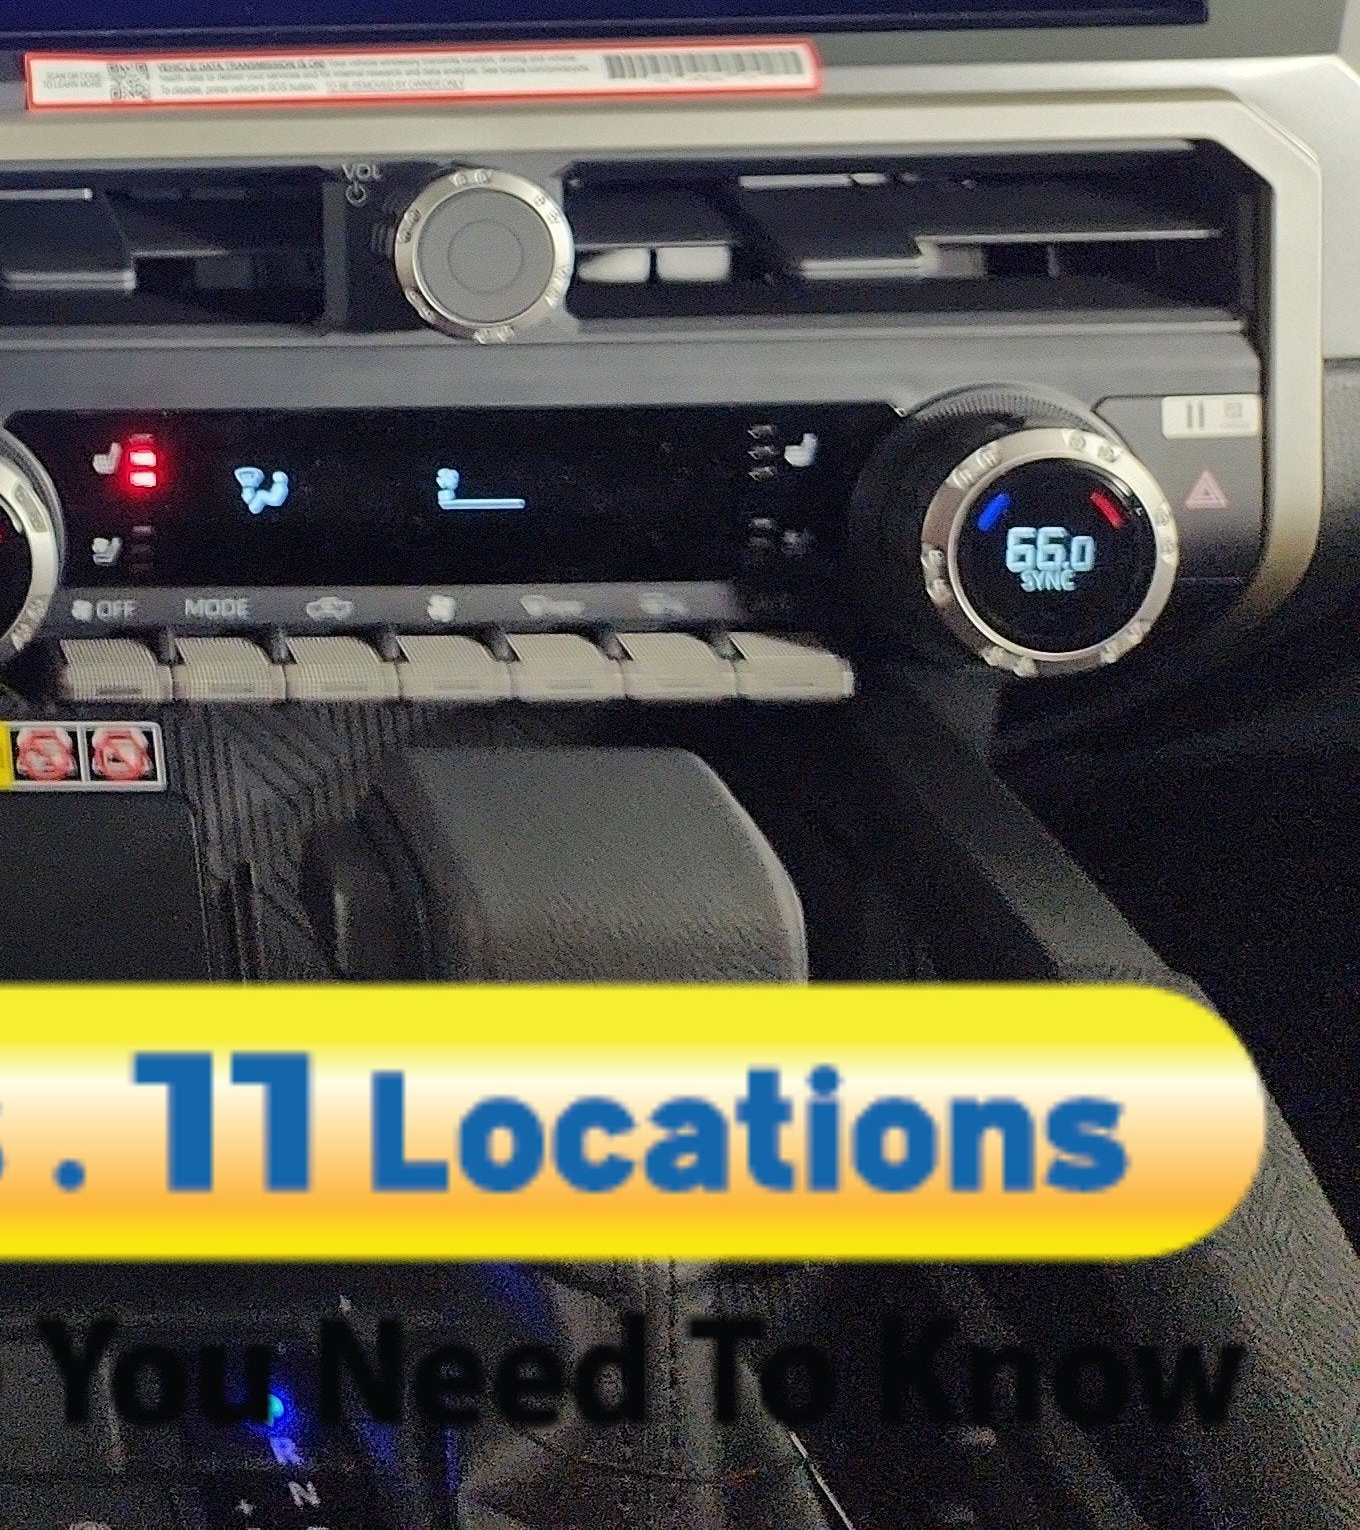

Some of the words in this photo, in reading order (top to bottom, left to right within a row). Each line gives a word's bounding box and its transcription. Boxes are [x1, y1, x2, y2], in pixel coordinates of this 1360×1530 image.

[341, 163, 383, 181] VOL
[1006, 525, 1096, 574] 66.0
[1020, 569, 1077, 593] SYNC
[96, 599, 138, 620] OFF
[185, 597, 253, 619] MODE
[288, 1480, 321, 1509] N
